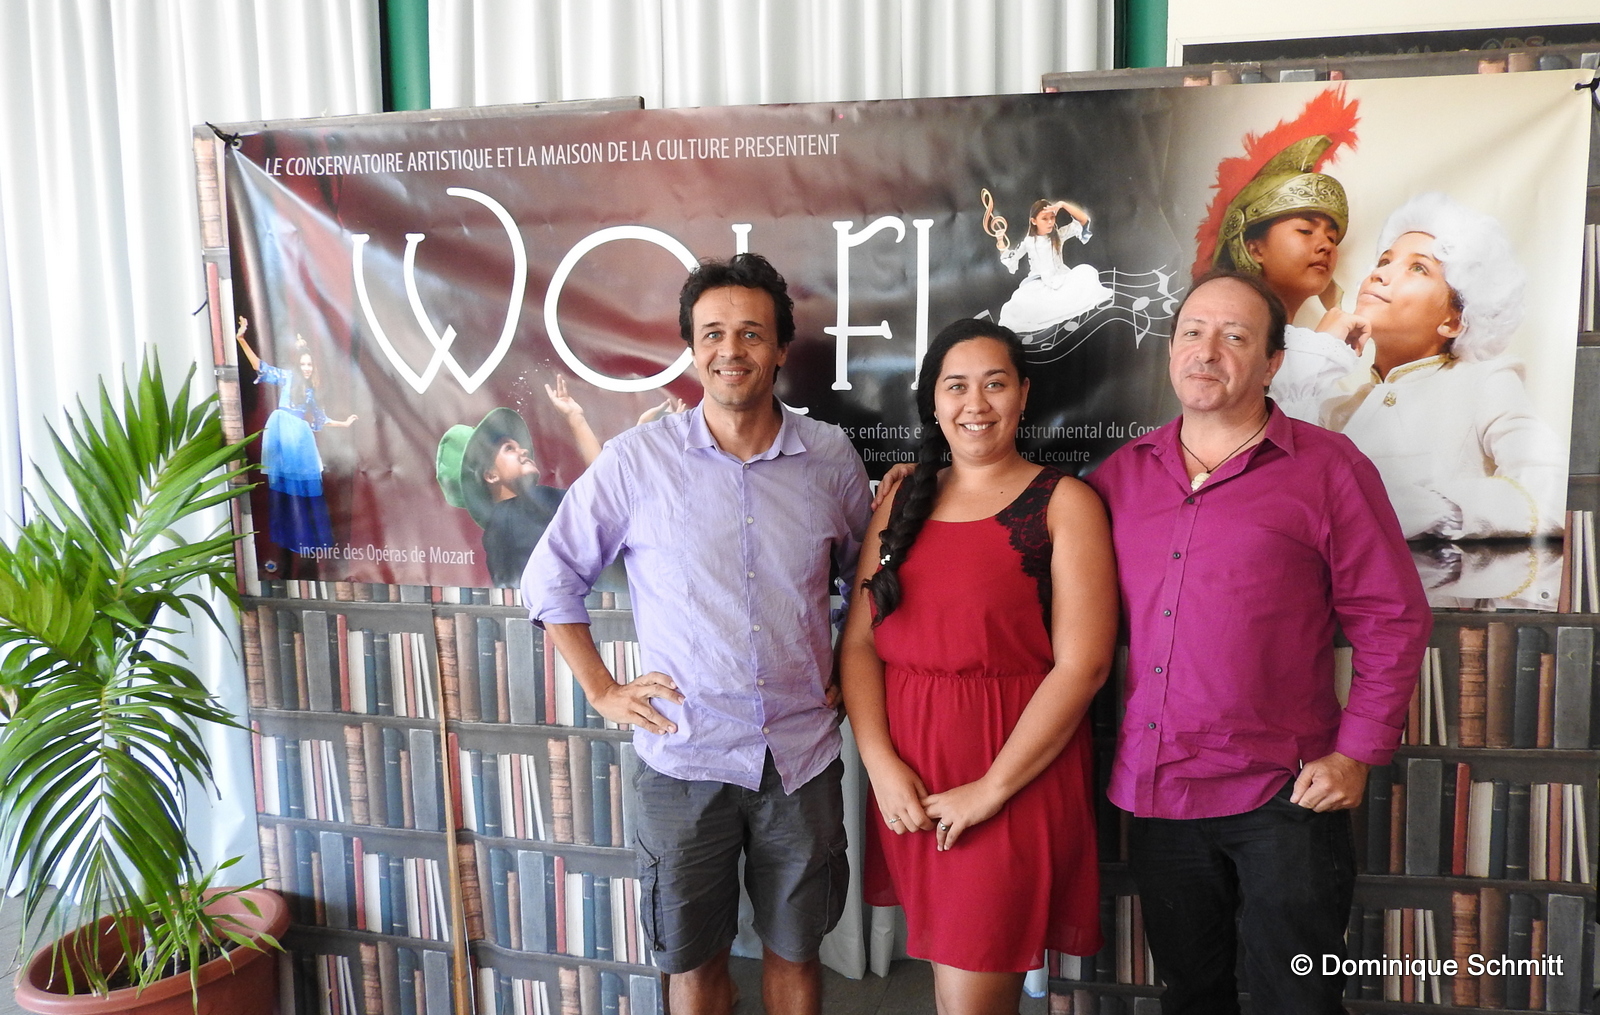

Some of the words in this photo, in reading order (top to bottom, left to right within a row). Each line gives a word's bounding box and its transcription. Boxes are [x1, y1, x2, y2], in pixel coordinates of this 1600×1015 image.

[265, 157, 283, 176] LE
[285, 152, 404, 176] CONSERVATOIRE
[407, 147, 494, 172] ARTISTIQUE
[496, 146, 514, 168] ET
[518, 145, 538, 168] LA
[541, 142, 603, 166] MAISON
[607, 141, 628, 163] DE
[632, 140, 652, 162] LA
[656, 137, 730, 161] CULTURE
[734, 133, 840, 159] PRESENTENT
[350, 186, 935, 394] WOFI
[859, 422, 910, 440] enfants
[1015, 421, 1102, 439] nstrumental
[1106, 421, 1124, 439] du
[863, 447, 915, 462] Direction
[1039, 448, 1090, 462] Lecoutre
[299, 542, 341, 564] inspiré
[343, 542, 365, 561] des
[366, 543, 408, 566] Opéras
[410, 545, 426, 563] de
[429, 546, 475, 565] Mozart
